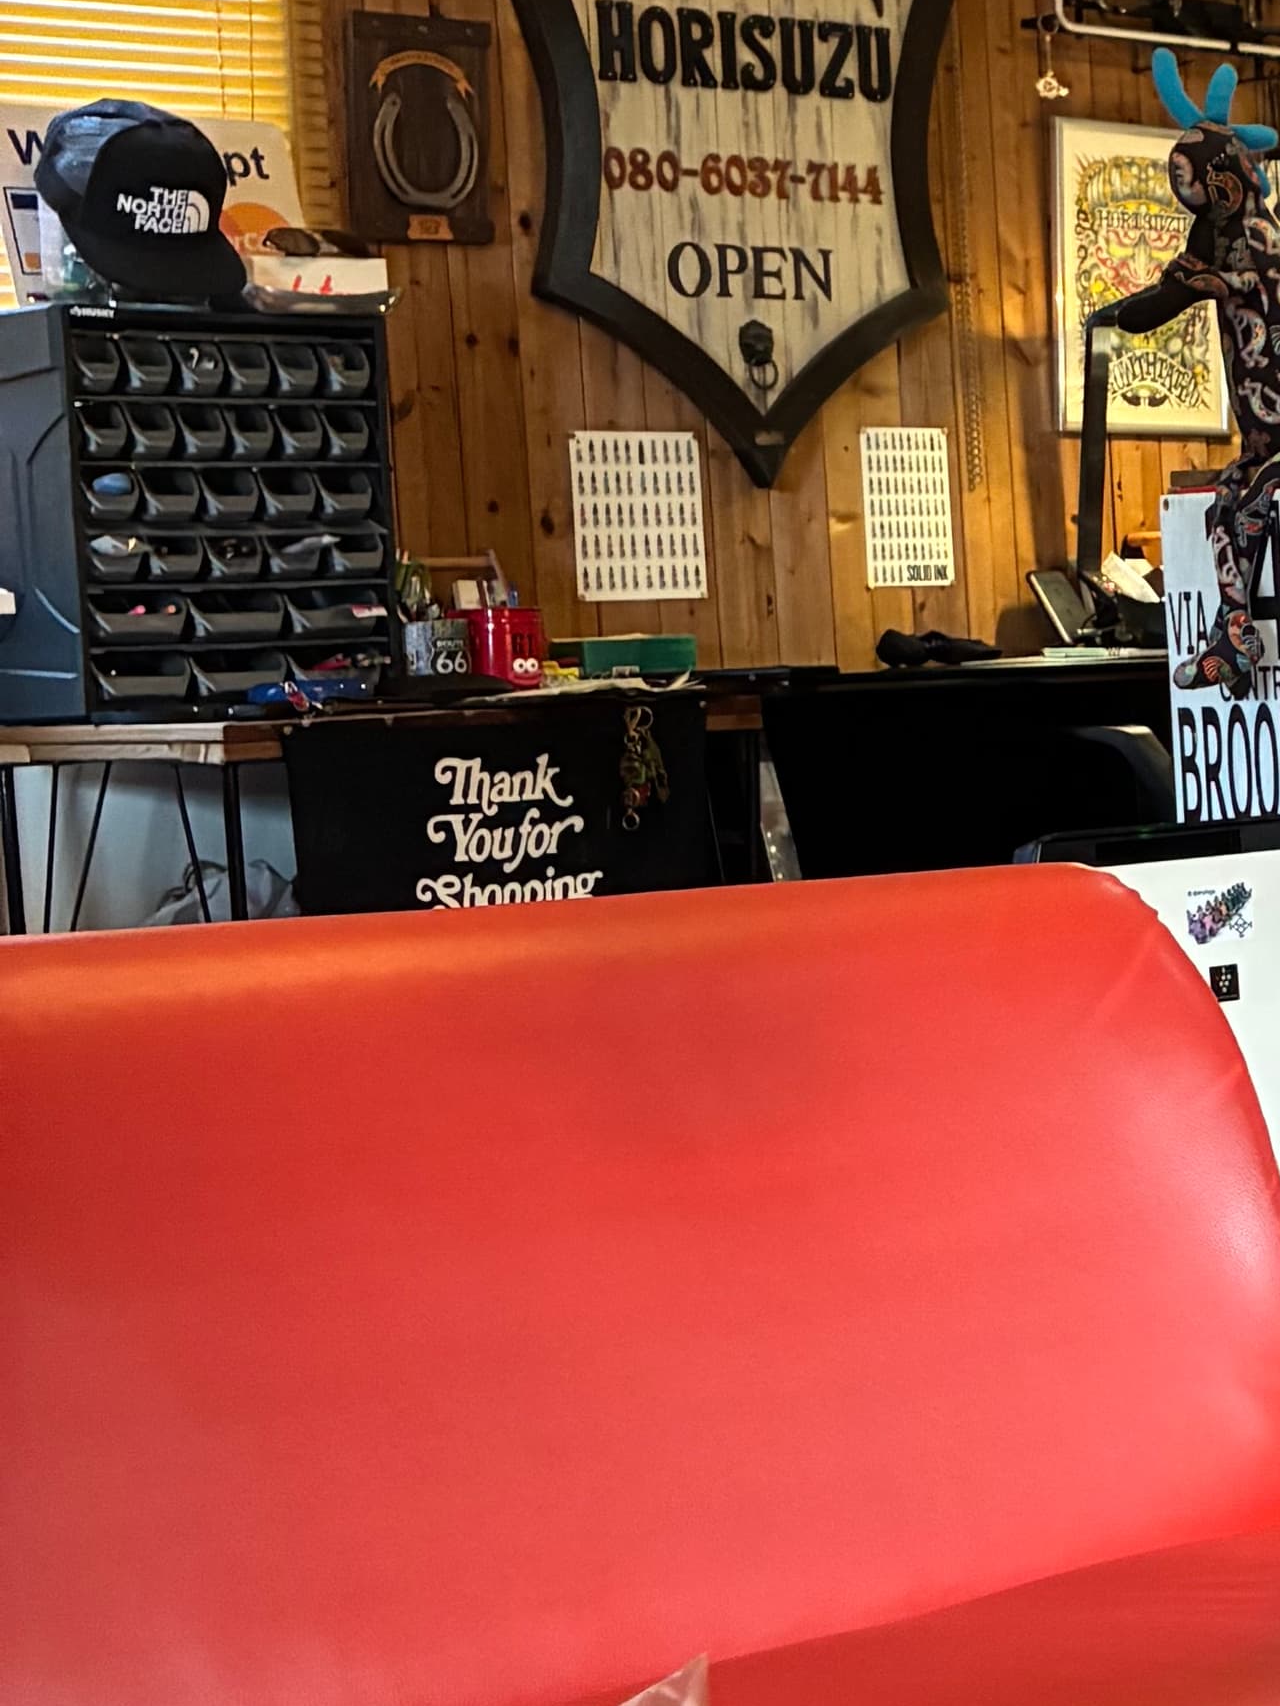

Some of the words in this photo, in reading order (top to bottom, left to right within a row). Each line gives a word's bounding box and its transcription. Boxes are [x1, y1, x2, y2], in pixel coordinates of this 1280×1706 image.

[594, 0, 892, 103] HORISUZU
[150, 186, 189, 207] THE
[602, 146, 885, 205] 080-6037-7144
[116, 193, 187, 221] NORTH
[134, 216, 185, 234] FACE
[667, 242, 833, 302] OPEN
[906, 565, 932, 582] SOLID
[933, 565, 949, 581] INK
[1167, 591, 1210, 656] VIA
[435, 649, 468, 674] 66
[433, 751, 575, 817] Thank
[426, 811, 515, 864] You
[502, 806, 585, 874] for
